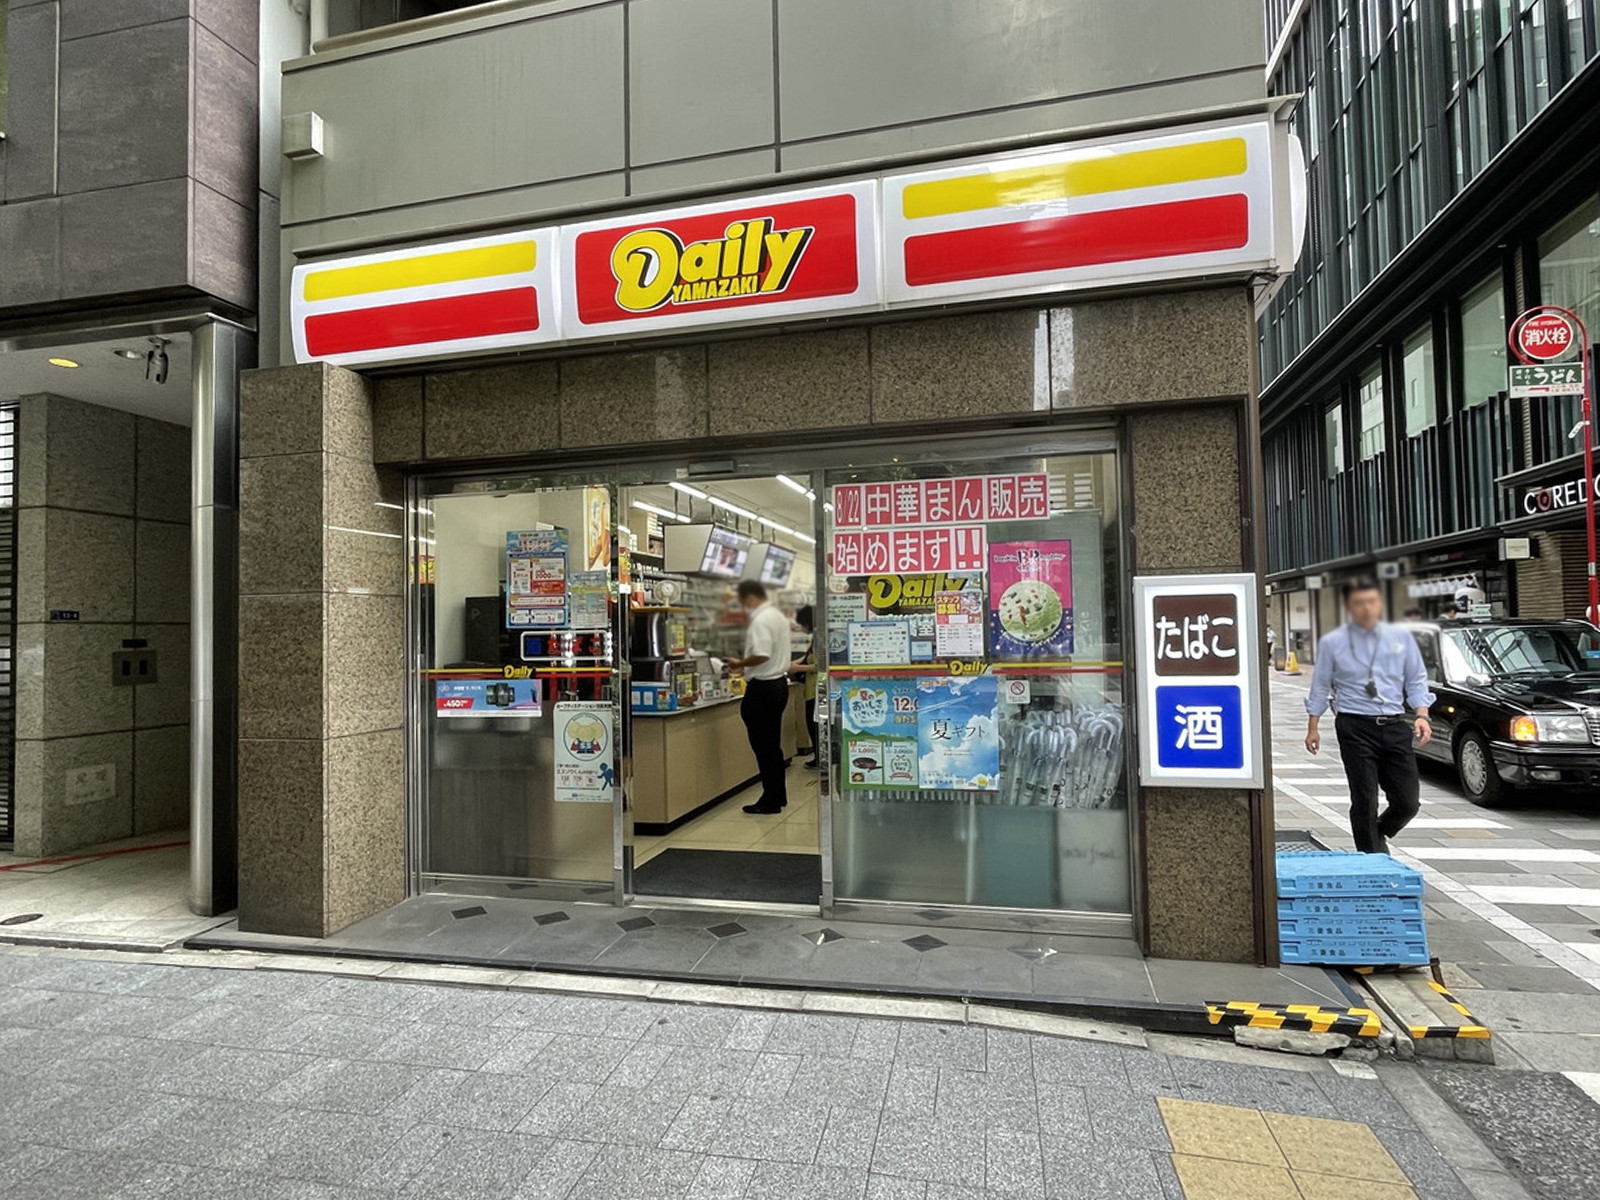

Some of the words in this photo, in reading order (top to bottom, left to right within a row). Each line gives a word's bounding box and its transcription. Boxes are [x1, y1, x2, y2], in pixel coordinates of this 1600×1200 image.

[612, 218, 812, 310] Daily
[673, 275, 759, 302] YAMAZAKI
[1525, 327, 1567, 346] 消火栓
[1534, 367, 1577, 385] うどん
[836, 476, 1045, 524] 8/22中華まん販売
[837, 528, 981, 572] 始めます!!
[898, 597, 936, 606] YAMAZA
[1156, 614, 1236, 659] たばこ
[504, 665, 533, 678] Daily
[950, 661, 987, 675] Daily
[853, 700, 882, 711] おいしさ
[930, 718, 985, 740] 夏ギフト
[1174, 704, 1223, 749] 酒
